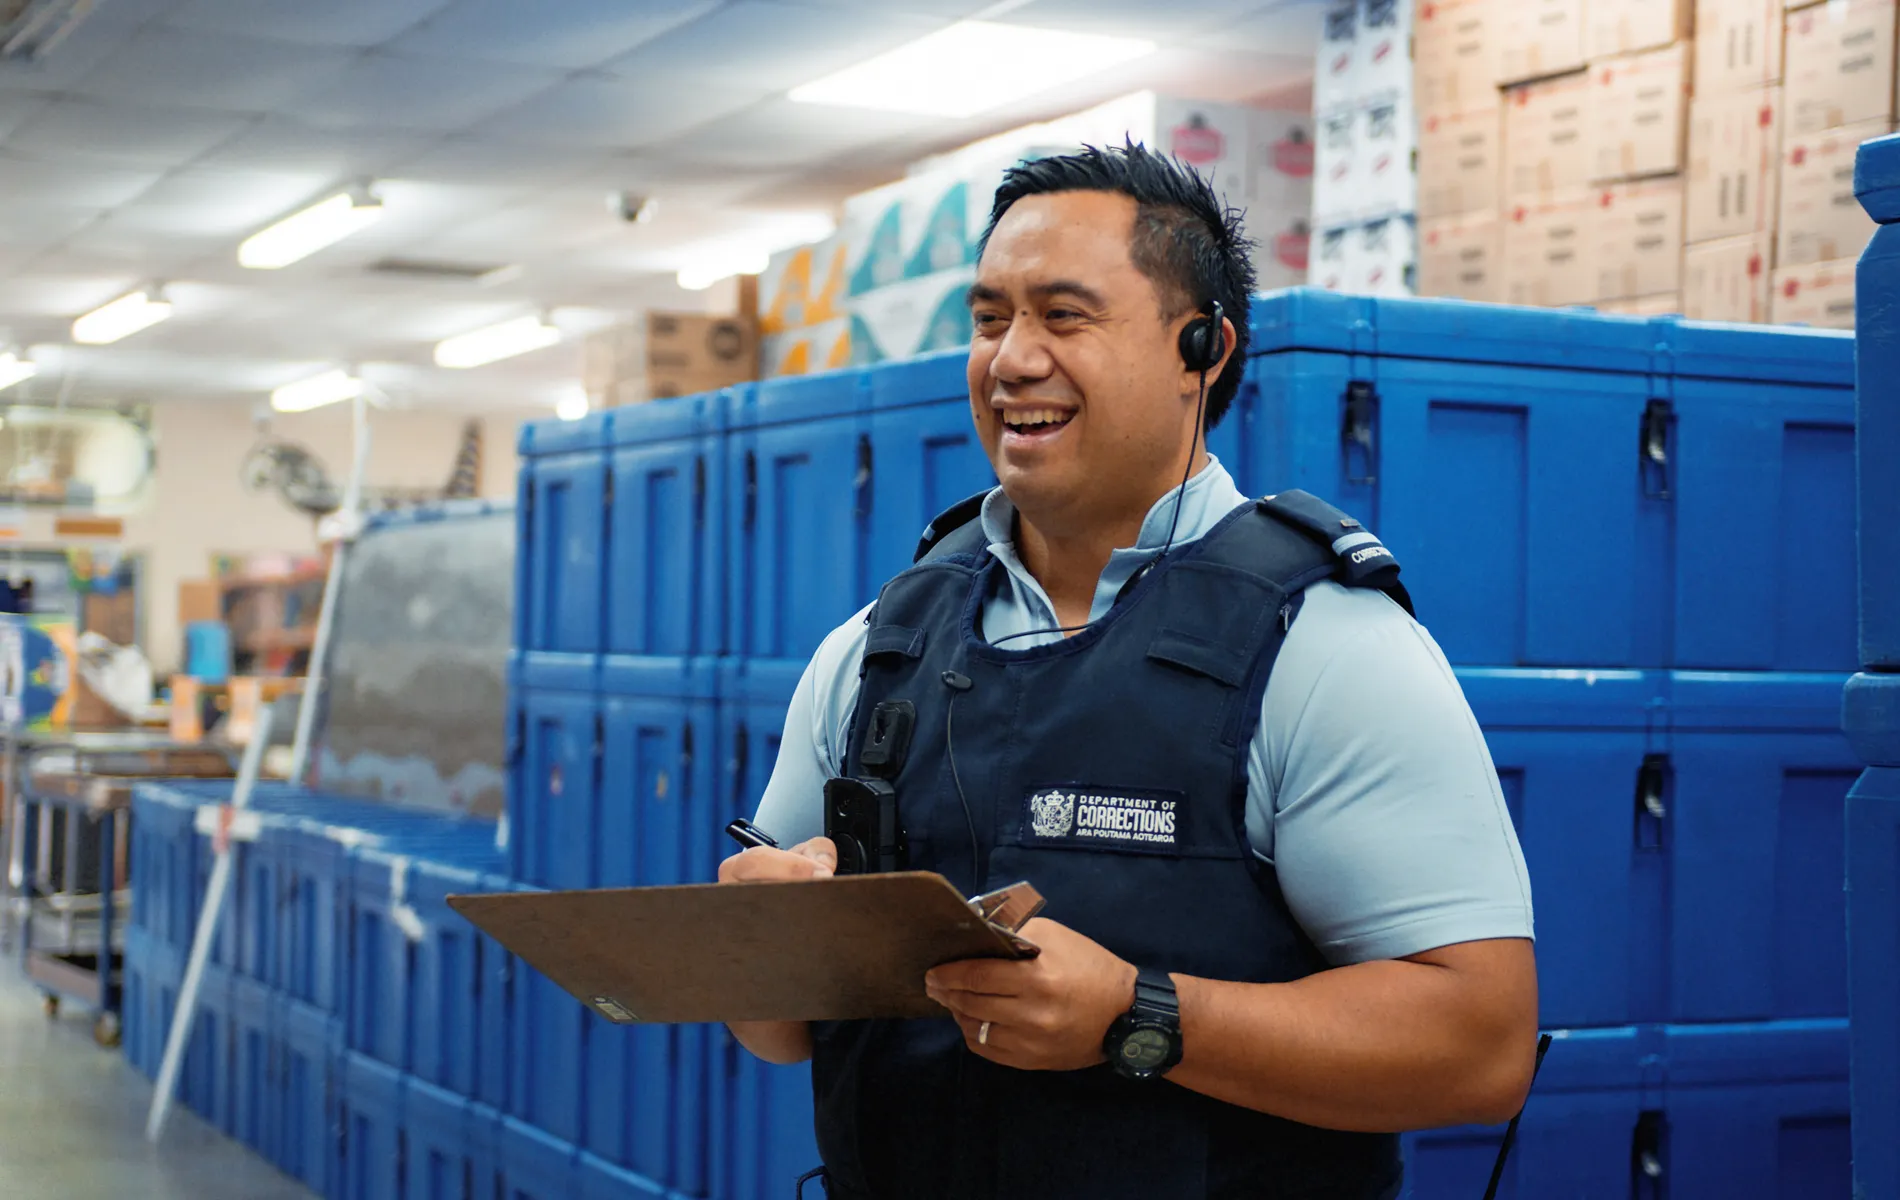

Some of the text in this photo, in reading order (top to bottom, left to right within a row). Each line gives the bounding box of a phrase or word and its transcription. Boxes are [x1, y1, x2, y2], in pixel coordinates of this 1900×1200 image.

[1080, 795, 1176, 810] DEPARTMENT OF
[1077, 805, 1175, 834] CORRECTIONS
[1076, 828, 1175, 843] ARA POUTAMA AOTEAROA
